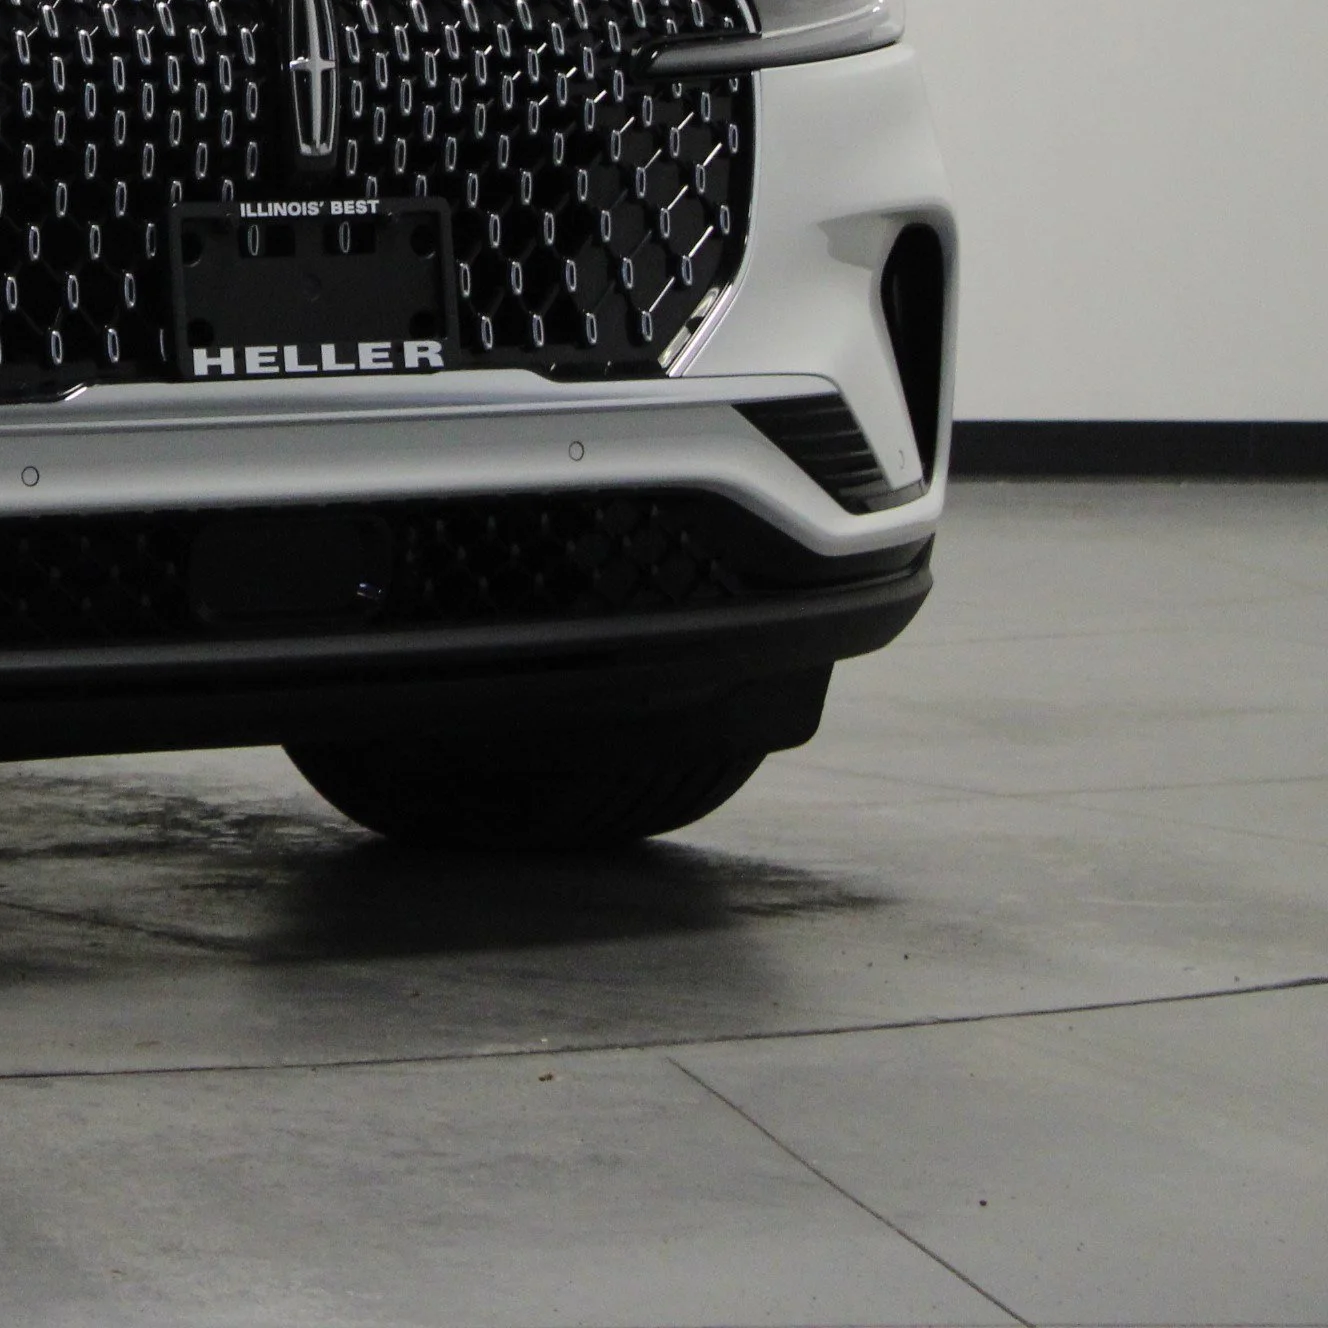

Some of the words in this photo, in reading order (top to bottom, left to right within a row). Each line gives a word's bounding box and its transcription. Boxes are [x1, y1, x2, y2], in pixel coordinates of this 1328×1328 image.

[240, 202, 324, 217] ILLINOIS'
[331, 199, 379, 214] BEST
[193, 340, 445, 376] HELLER
